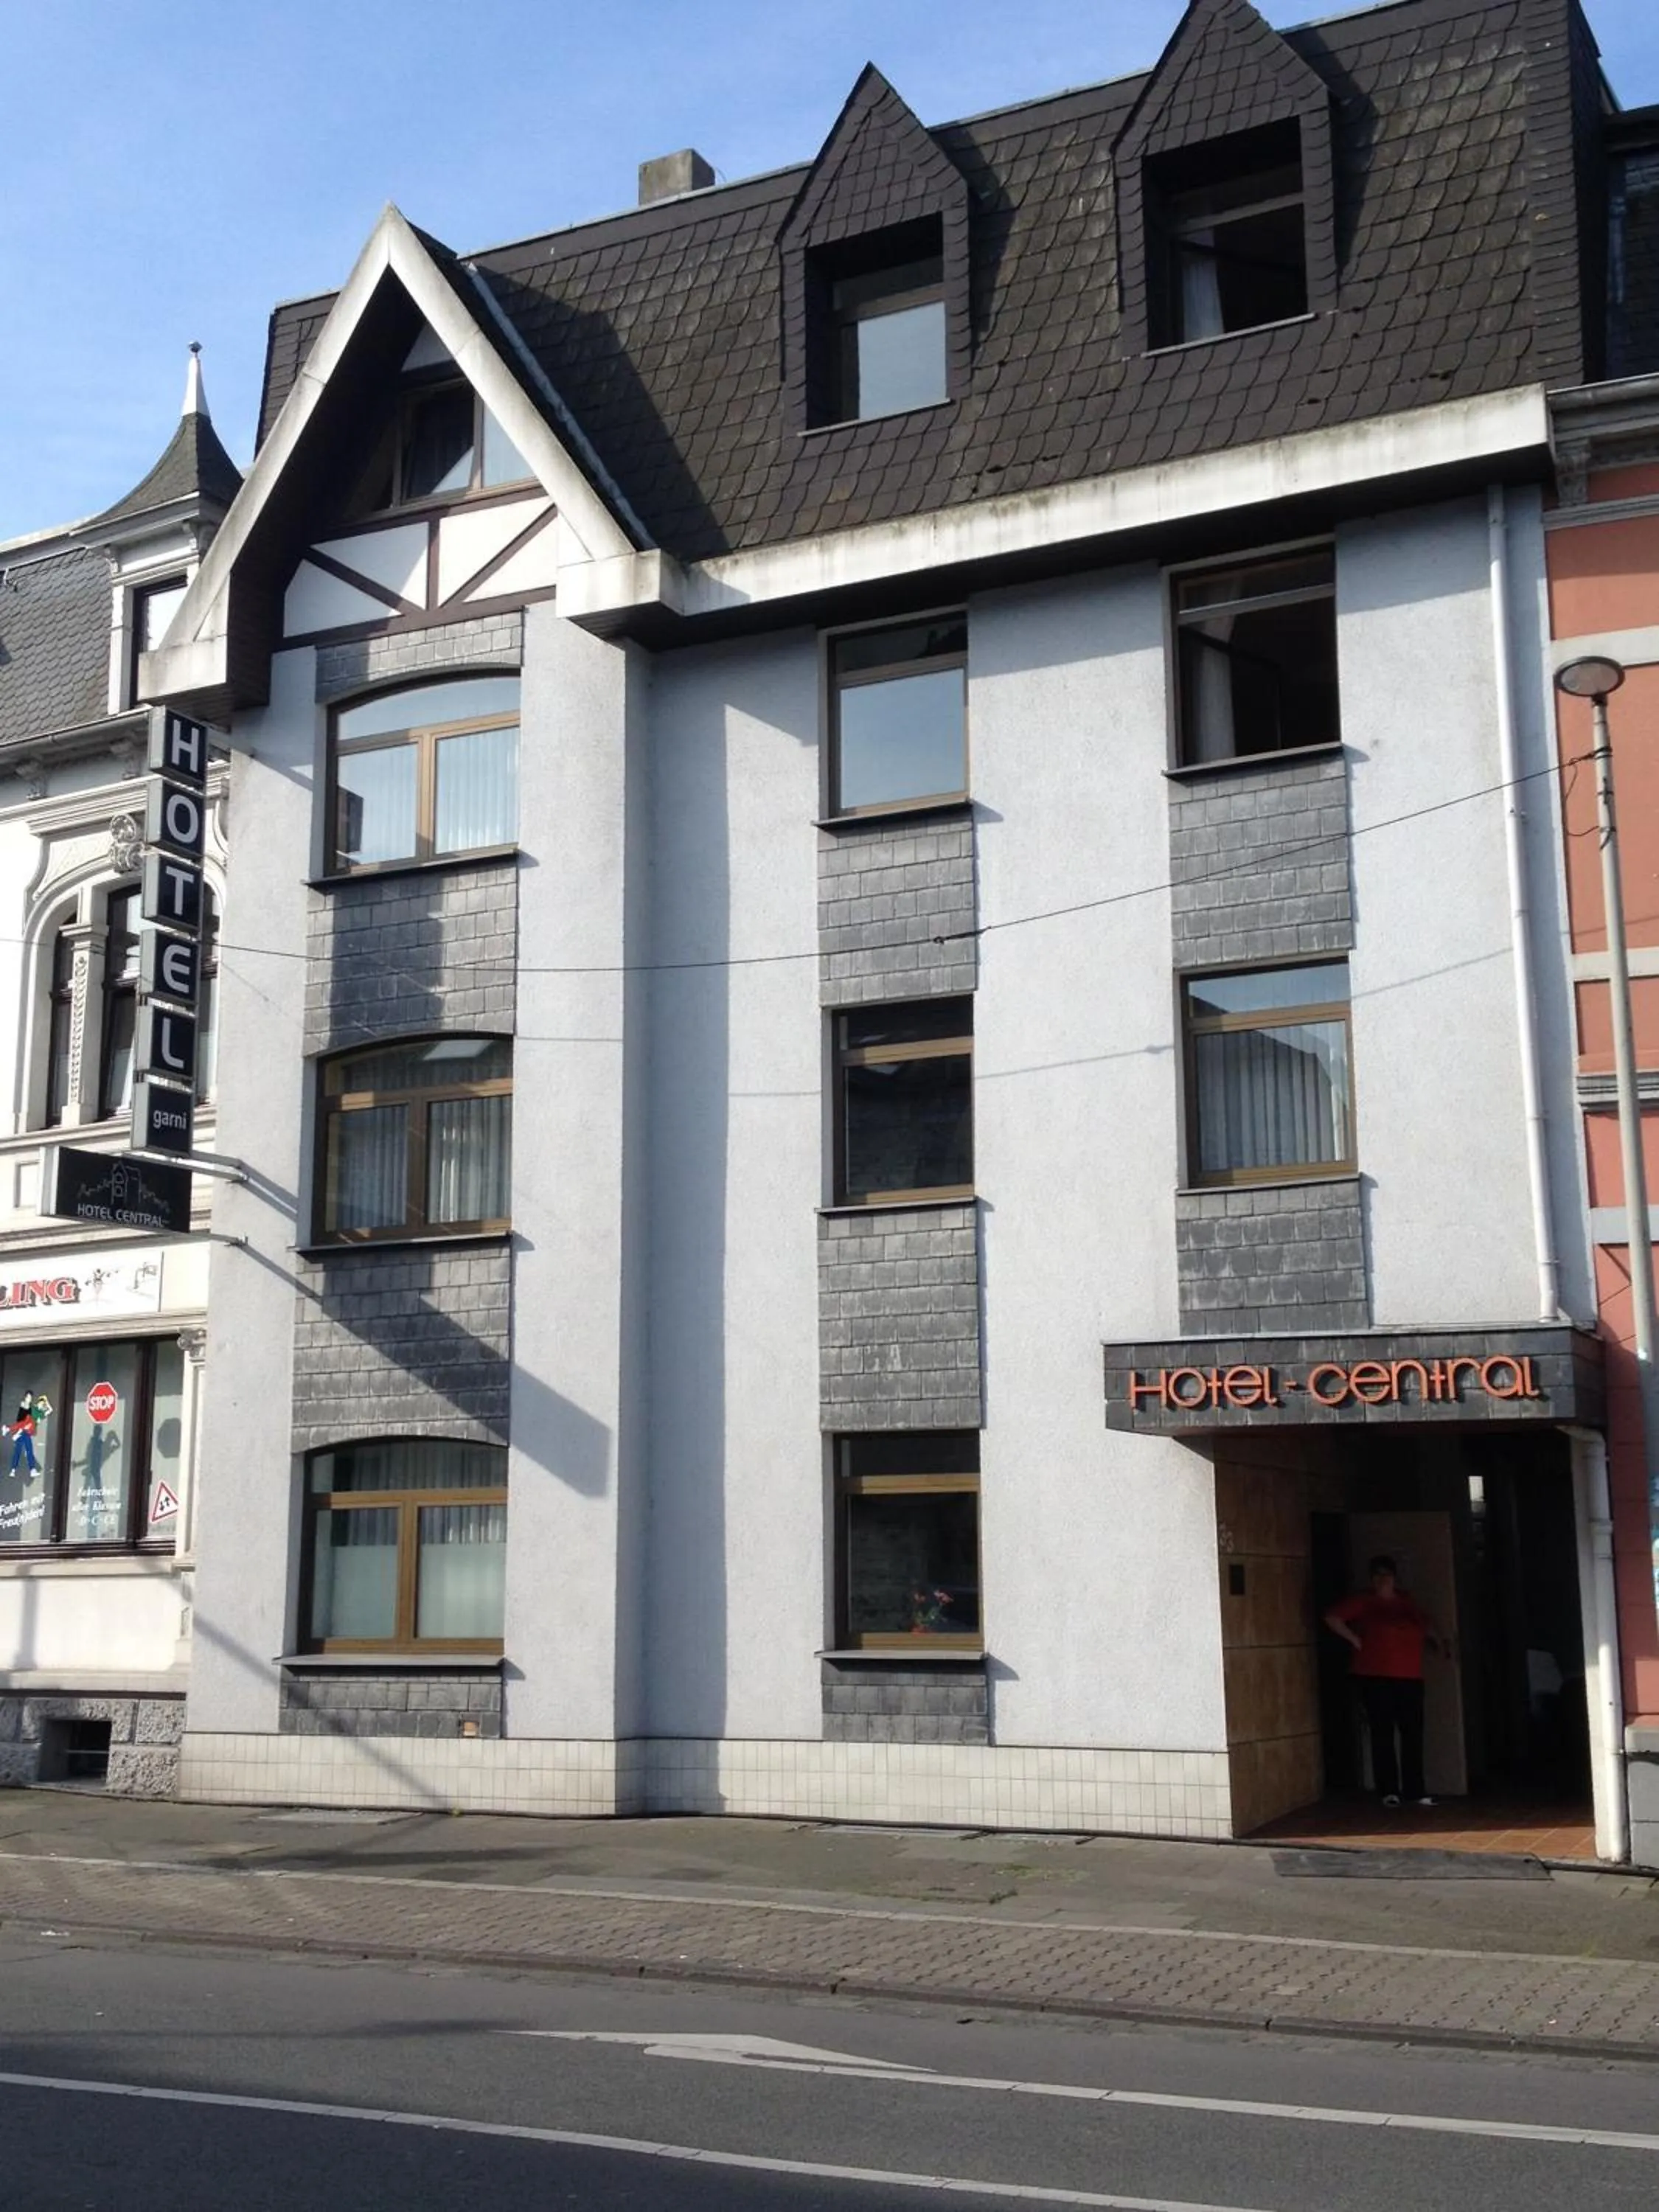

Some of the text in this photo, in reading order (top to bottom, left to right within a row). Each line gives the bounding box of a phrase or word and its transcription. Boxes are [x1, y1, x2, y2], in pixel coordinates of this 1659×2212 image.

[160, 718, 200, 1068] HOTEL
[153, 1110, 187, 1130] garni
[77, 1203, 164, 1228] HOTEL CENTRAL
[88, 1396, 114, 1411] STOP
